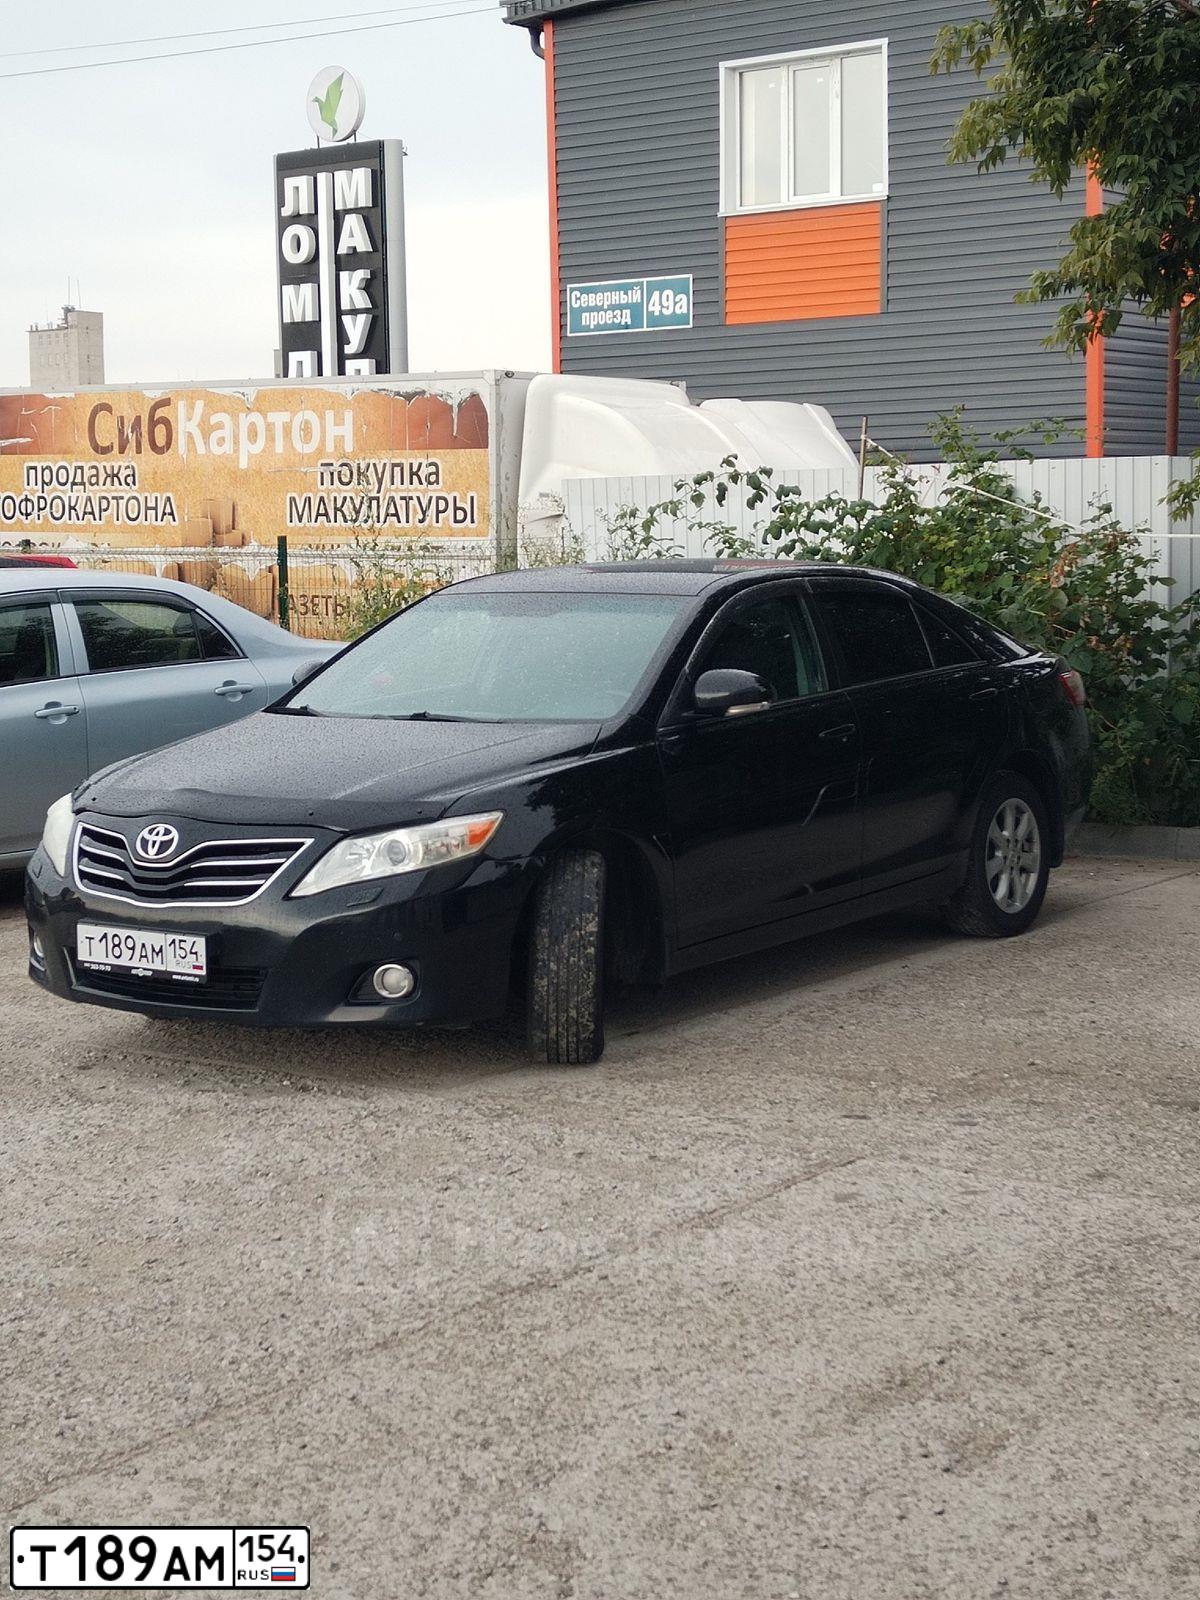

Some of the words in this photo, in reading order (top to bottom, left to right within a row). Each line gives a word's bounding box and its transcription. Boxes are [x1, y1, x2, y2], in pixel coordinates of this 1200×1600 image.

[571, 286, 641, 309] Северный
[648, 289, 688, 316] 49а
[581, 309, 632, 329] проезд
[87, 397, 354, 469] СибКартон
[26, 464, 137, 493] продажа
[320, 460, 440, 494] покупка
[0, 494, 177, 522] ОФРОКАРТОНА
[288, 495, 476, 525] МАКУЛАТУРЫ
[168, 938, 199, 961] 154
